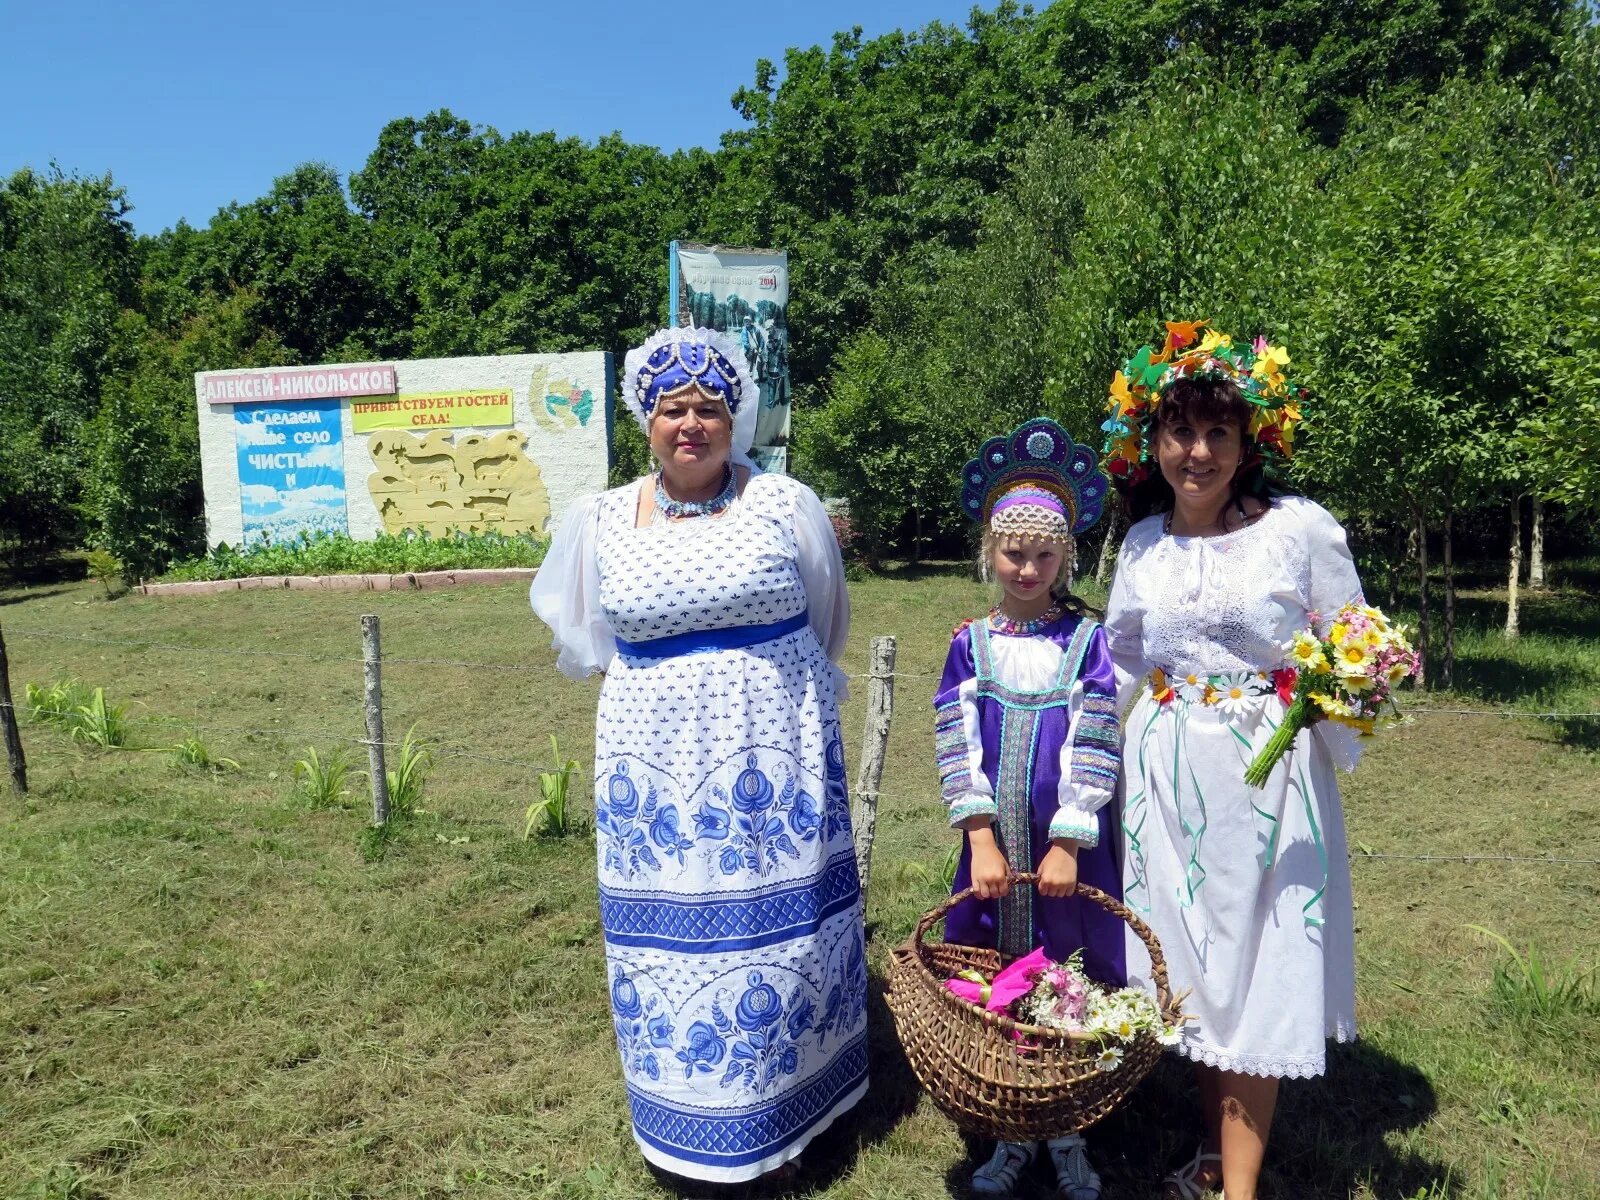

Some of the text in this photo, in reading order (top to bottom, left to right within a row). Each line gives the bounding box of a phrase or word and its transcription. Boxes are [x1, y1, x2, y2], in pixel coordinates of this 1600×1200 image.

[207, 371, 392, 399] АЛЕКСЕЙ-НИКОЛЬСКОЕ
[354, 393, 508, 414] ПРИВЕТСТВУЕМ ГОСТЕЙ
[252, 411, 322, 426] Сделаем
[411, 414, 450, 426] СЕЛА!
[293, 431, 331, 444] село
